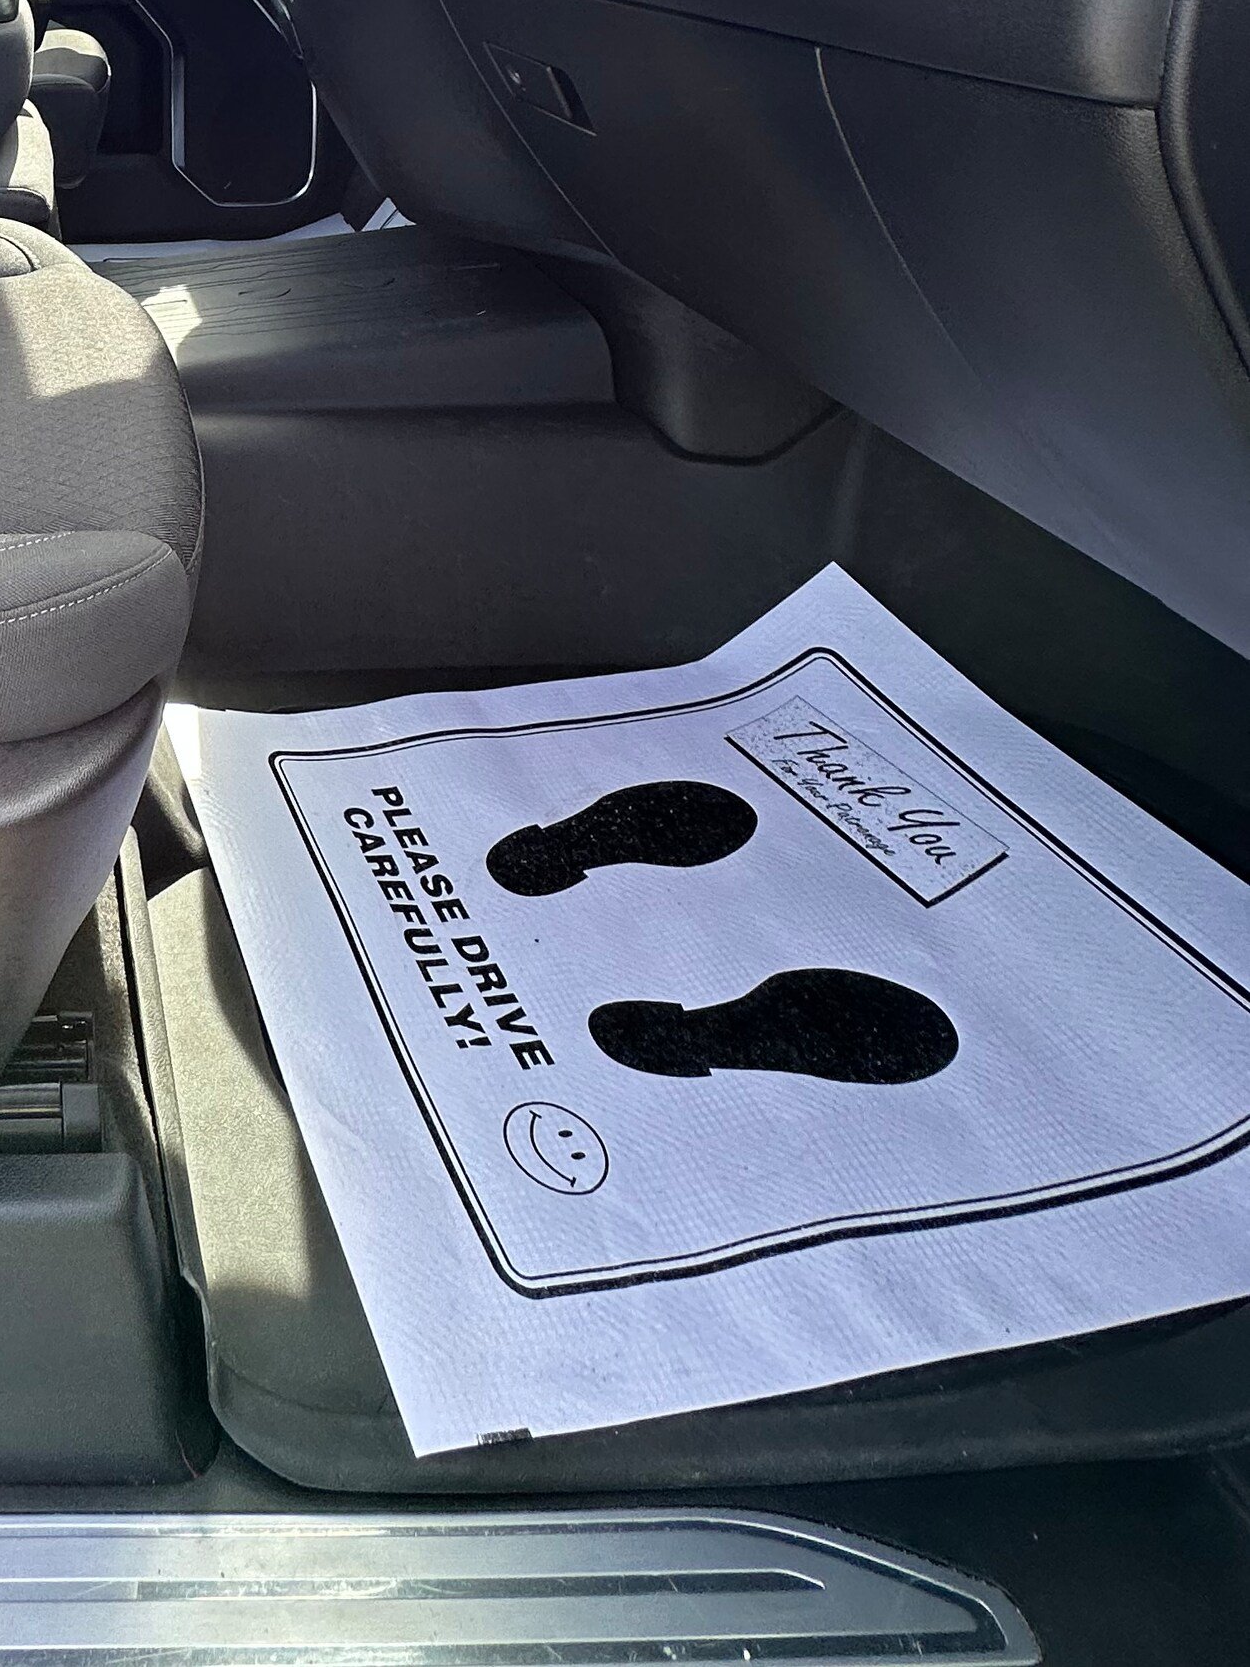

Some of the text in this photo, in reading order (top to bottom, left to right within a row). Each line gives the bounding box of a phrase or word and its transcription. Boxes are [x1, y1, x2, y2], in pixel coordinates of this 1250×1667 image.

[772, 758, 798, 777] For
[827, 803, 896, 857] Patronage
[774, 721, 960, 865] Thank You
[344, 808, 491, 1049] CAREFULLY!
[372, 786, 554, 1069] PLEASE DRIVE
